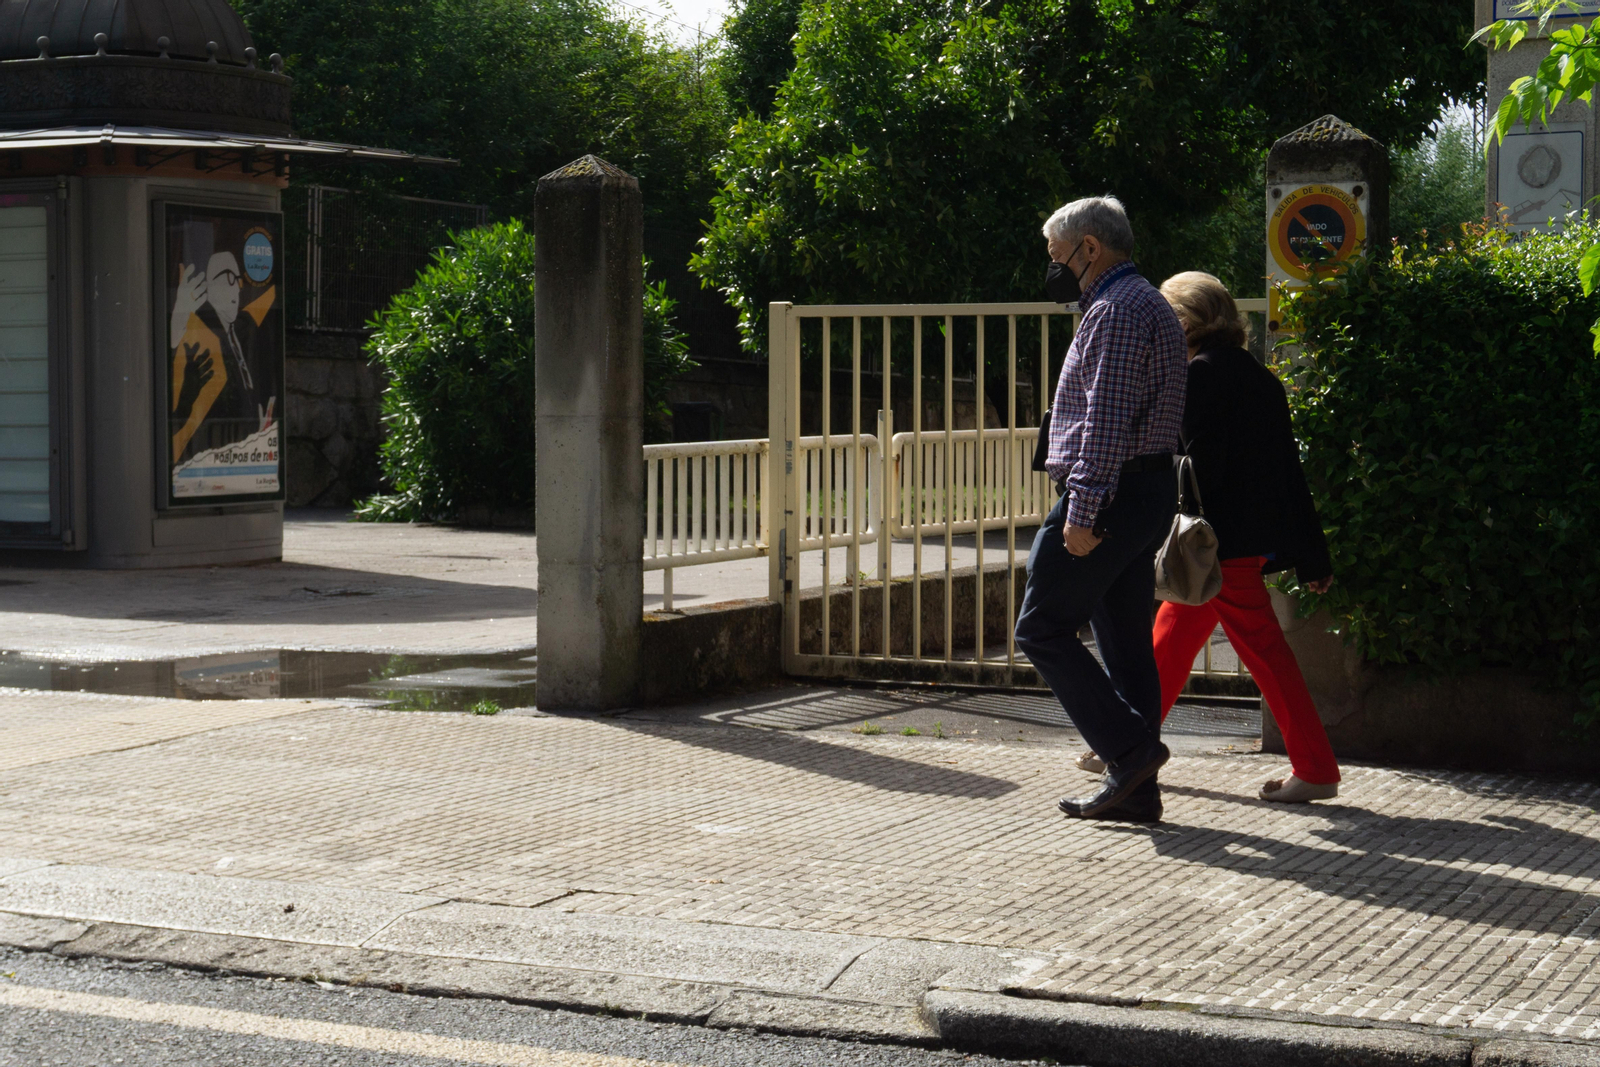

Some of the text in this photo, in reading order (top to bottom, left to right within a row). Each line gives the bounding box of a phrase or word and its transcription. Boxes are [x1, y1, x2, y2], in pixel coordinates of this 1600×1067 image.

[1275, 186, 1359, 218] SALIDA DE VEHICULOS
[246, 245, 272, 257] GRATIS
[251, 447, 262, 462] de
